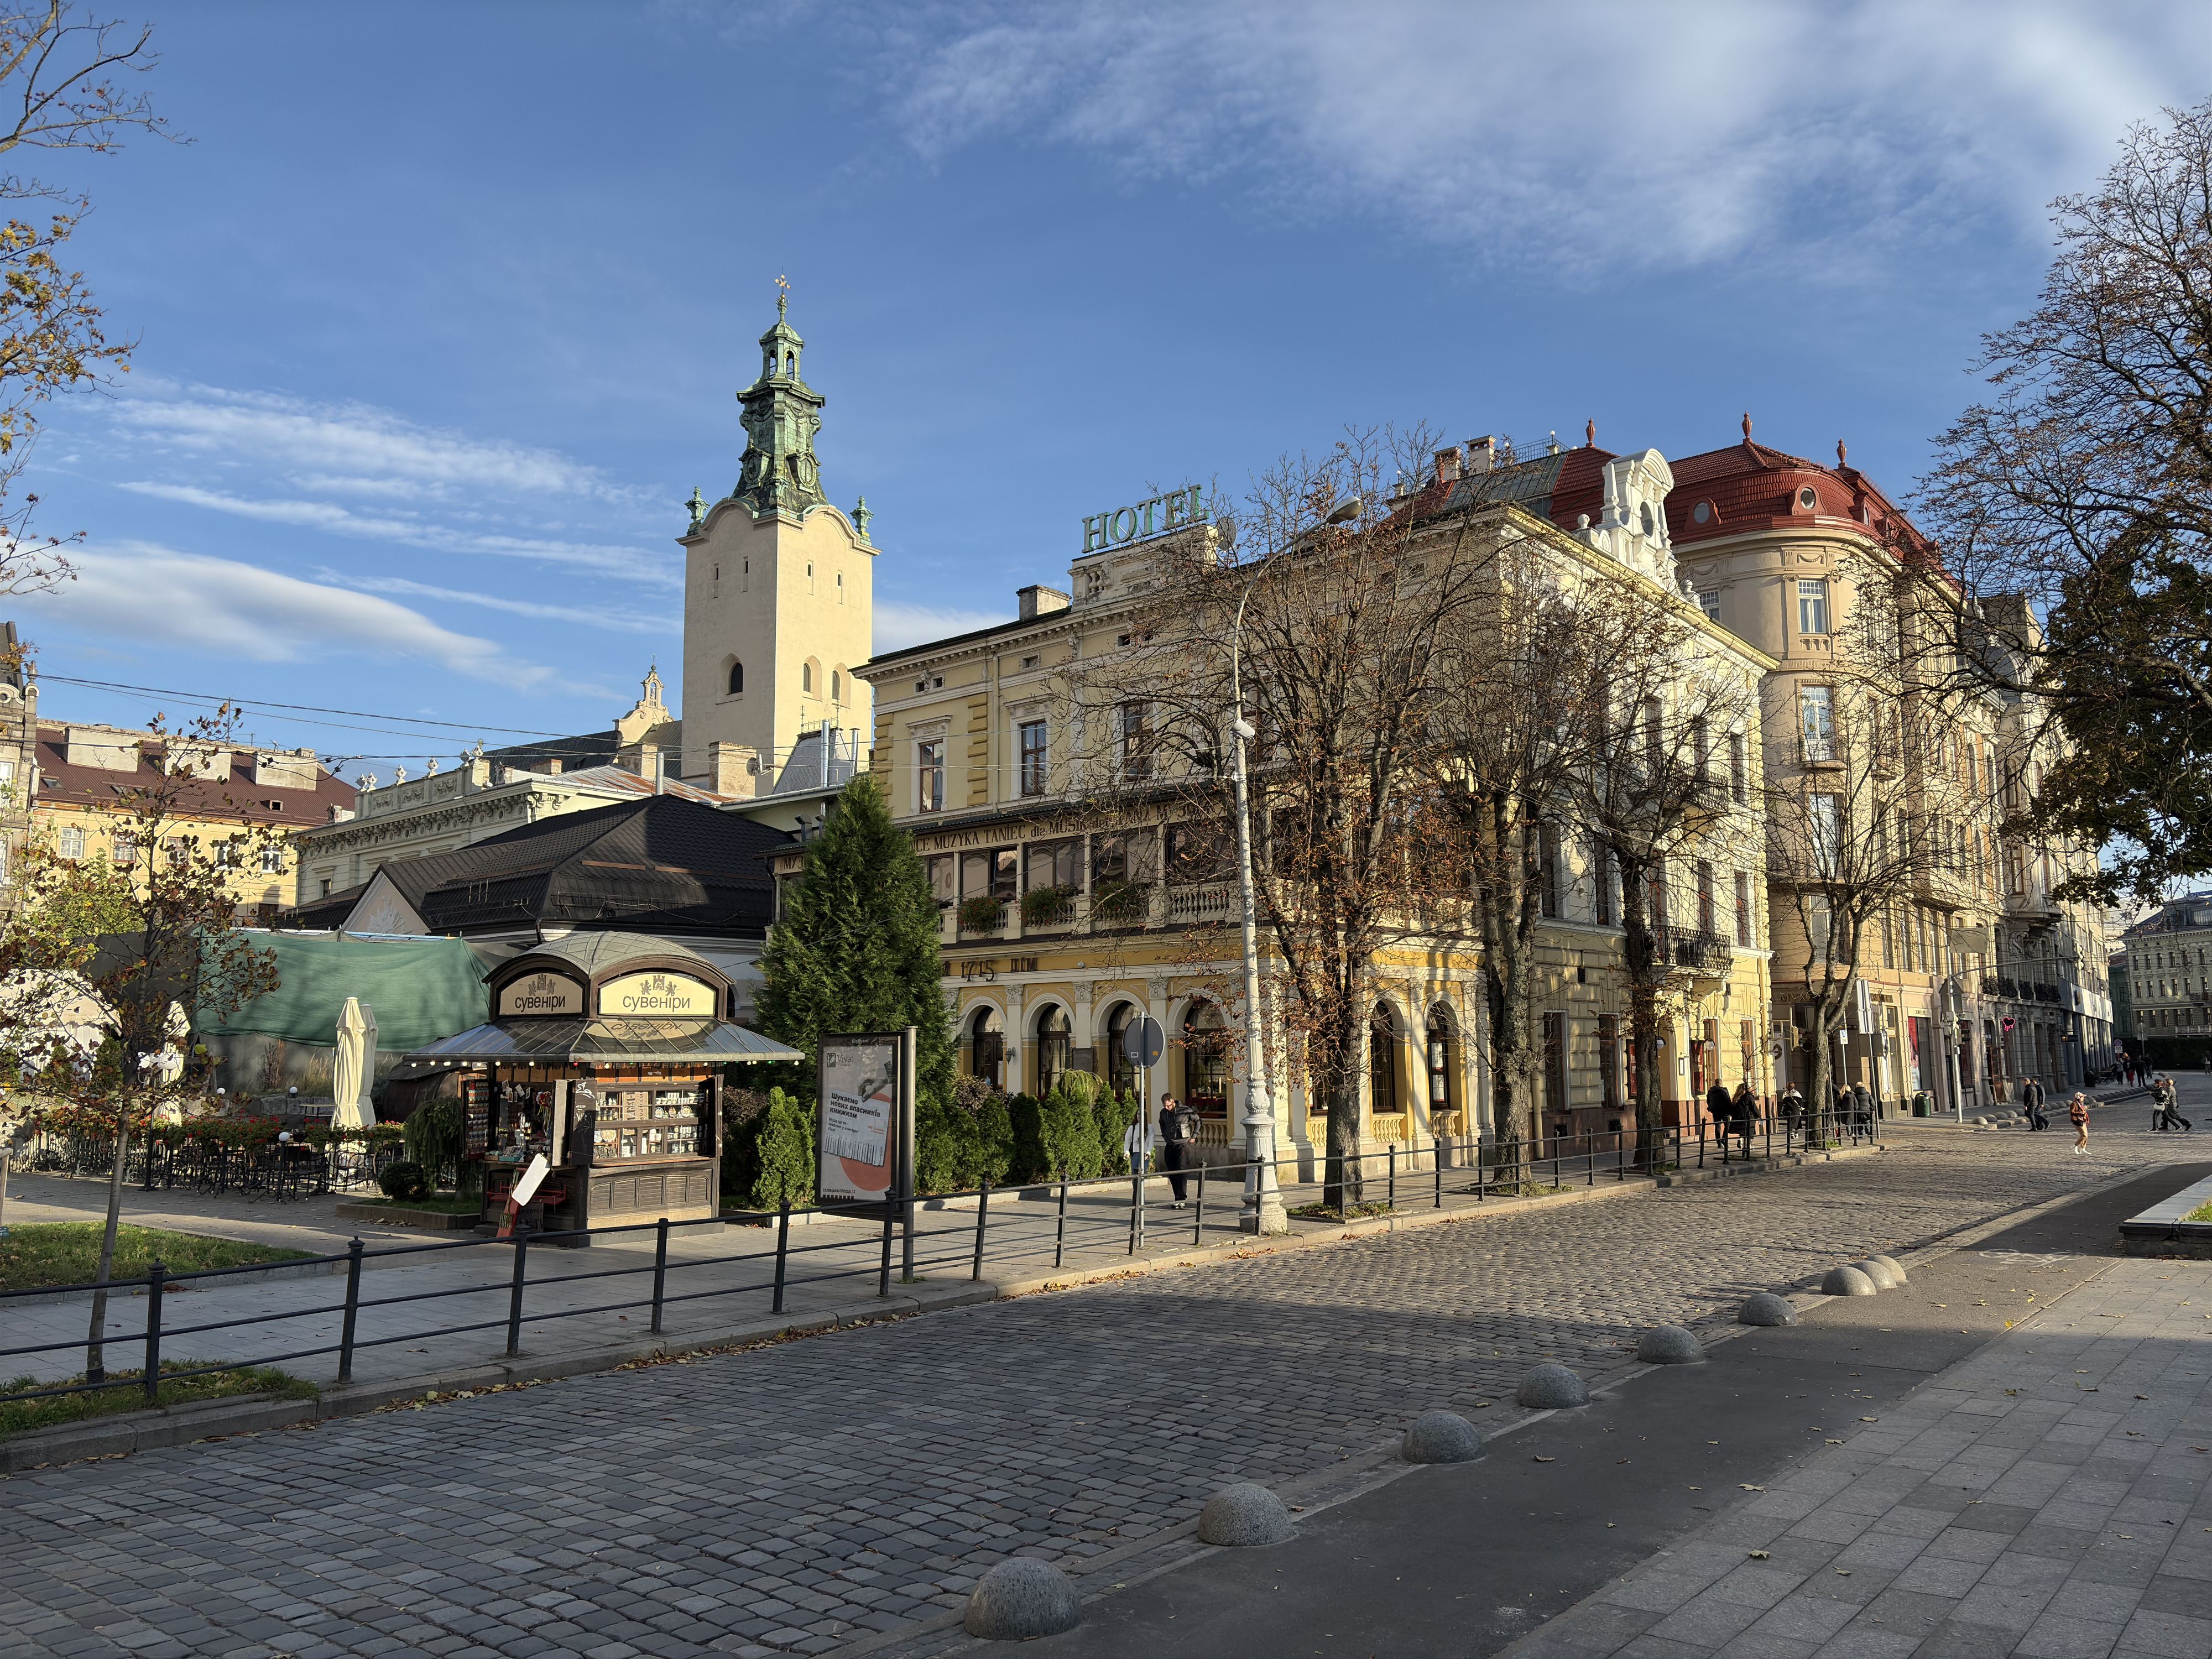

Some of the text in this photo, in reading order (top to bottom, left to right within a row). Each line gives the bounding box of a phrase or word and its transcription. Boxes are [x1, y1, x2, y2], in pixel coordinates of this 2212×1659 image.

[1082, 484, 1209, 554] HOTEL
[911, 838, 930, 852] NCE
[934, 831, 979, 850] MUZYKA
[984, 824, 1025, 843] TANIEC
[784, 855, 804, 870] МУЗ
[961, 959, 995, 982] 1715
[515, 994, 566, 1013] сувеніри
[622, 994, 691, 1012] сувеніри
[837, 1055, 854, 1063] Vivat
[831, 1092, 858, 1105] Шукаємо
[830, 1107, 857, 1119] книжкам
[831, 1100, 880, 1117] нових власників
